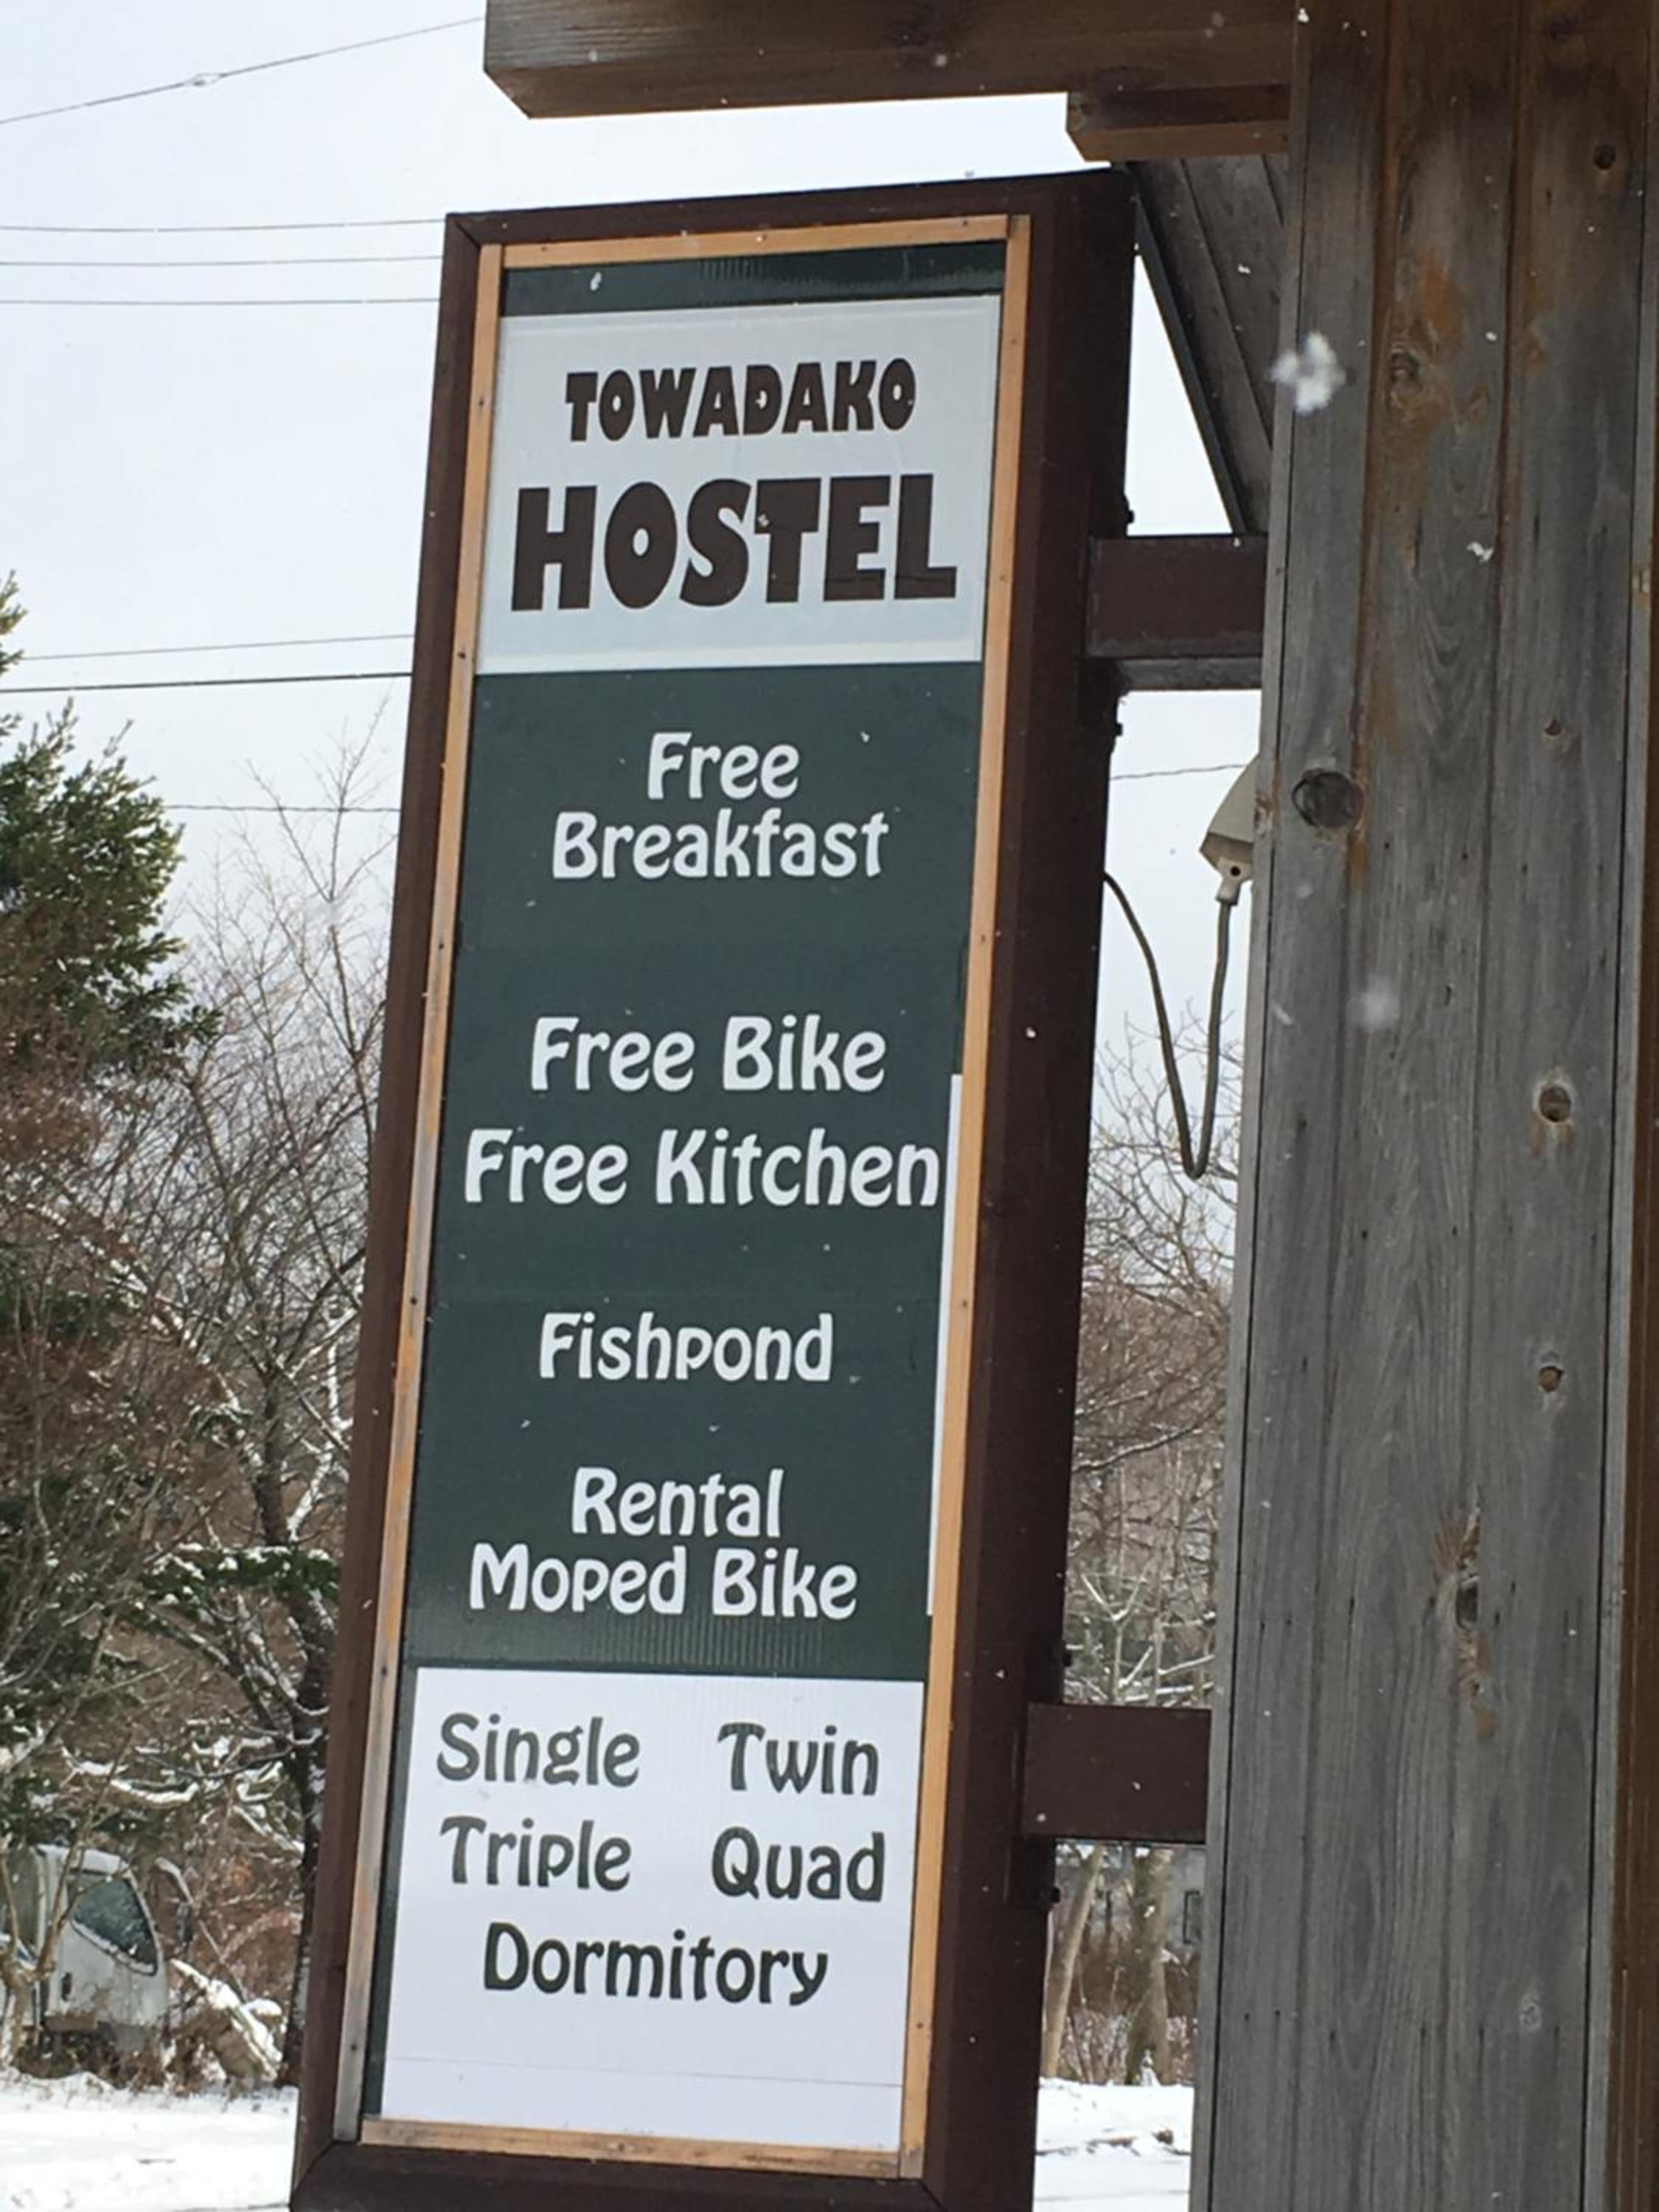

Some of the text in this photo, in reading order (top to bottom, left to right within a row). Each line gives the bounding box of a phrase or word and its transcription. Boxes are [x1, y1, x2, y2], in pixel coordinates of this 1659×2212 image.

[566, 358, 916, 441] TOWADAKO
[512, 473, 957, 611] HOSTEL
[648, 733, 799, 799] Free
[553, 808, 888, 878] Breakfast
[532, 1015, 885, 1091] Free Bike
[465, 1128, 939, 1206] Free Kitchen
[540, 1312, 832, 1380] Fishpond
[572, 1467, 783, 1537] Rental
[470, 1544, 856, 1619] Moped Bike
[437, 1714, 878, 1795] Single Twin
[441, 1815, 885, 1902] Triple Quad
[484, 1922, 827, 2006] Dormitory
